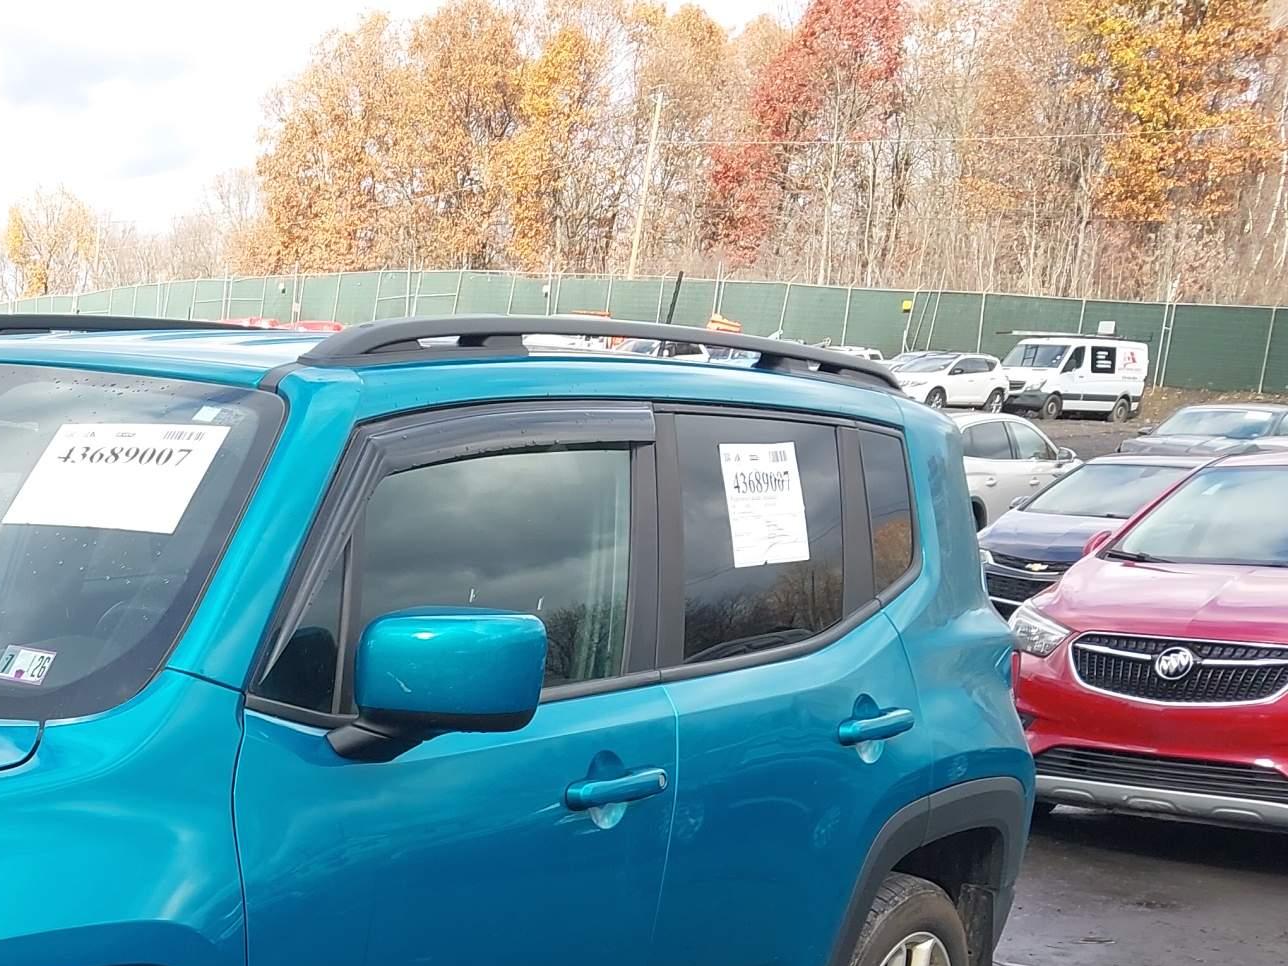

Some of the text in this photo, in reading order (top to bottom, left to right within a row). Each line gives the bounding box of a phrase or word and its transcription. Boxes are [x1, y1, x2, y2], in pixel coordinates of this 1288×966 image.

[58, 446, 193, 466] 43689007
[734, 471, 790, 493] 43689007
[30, 655, 52, 679] 26
